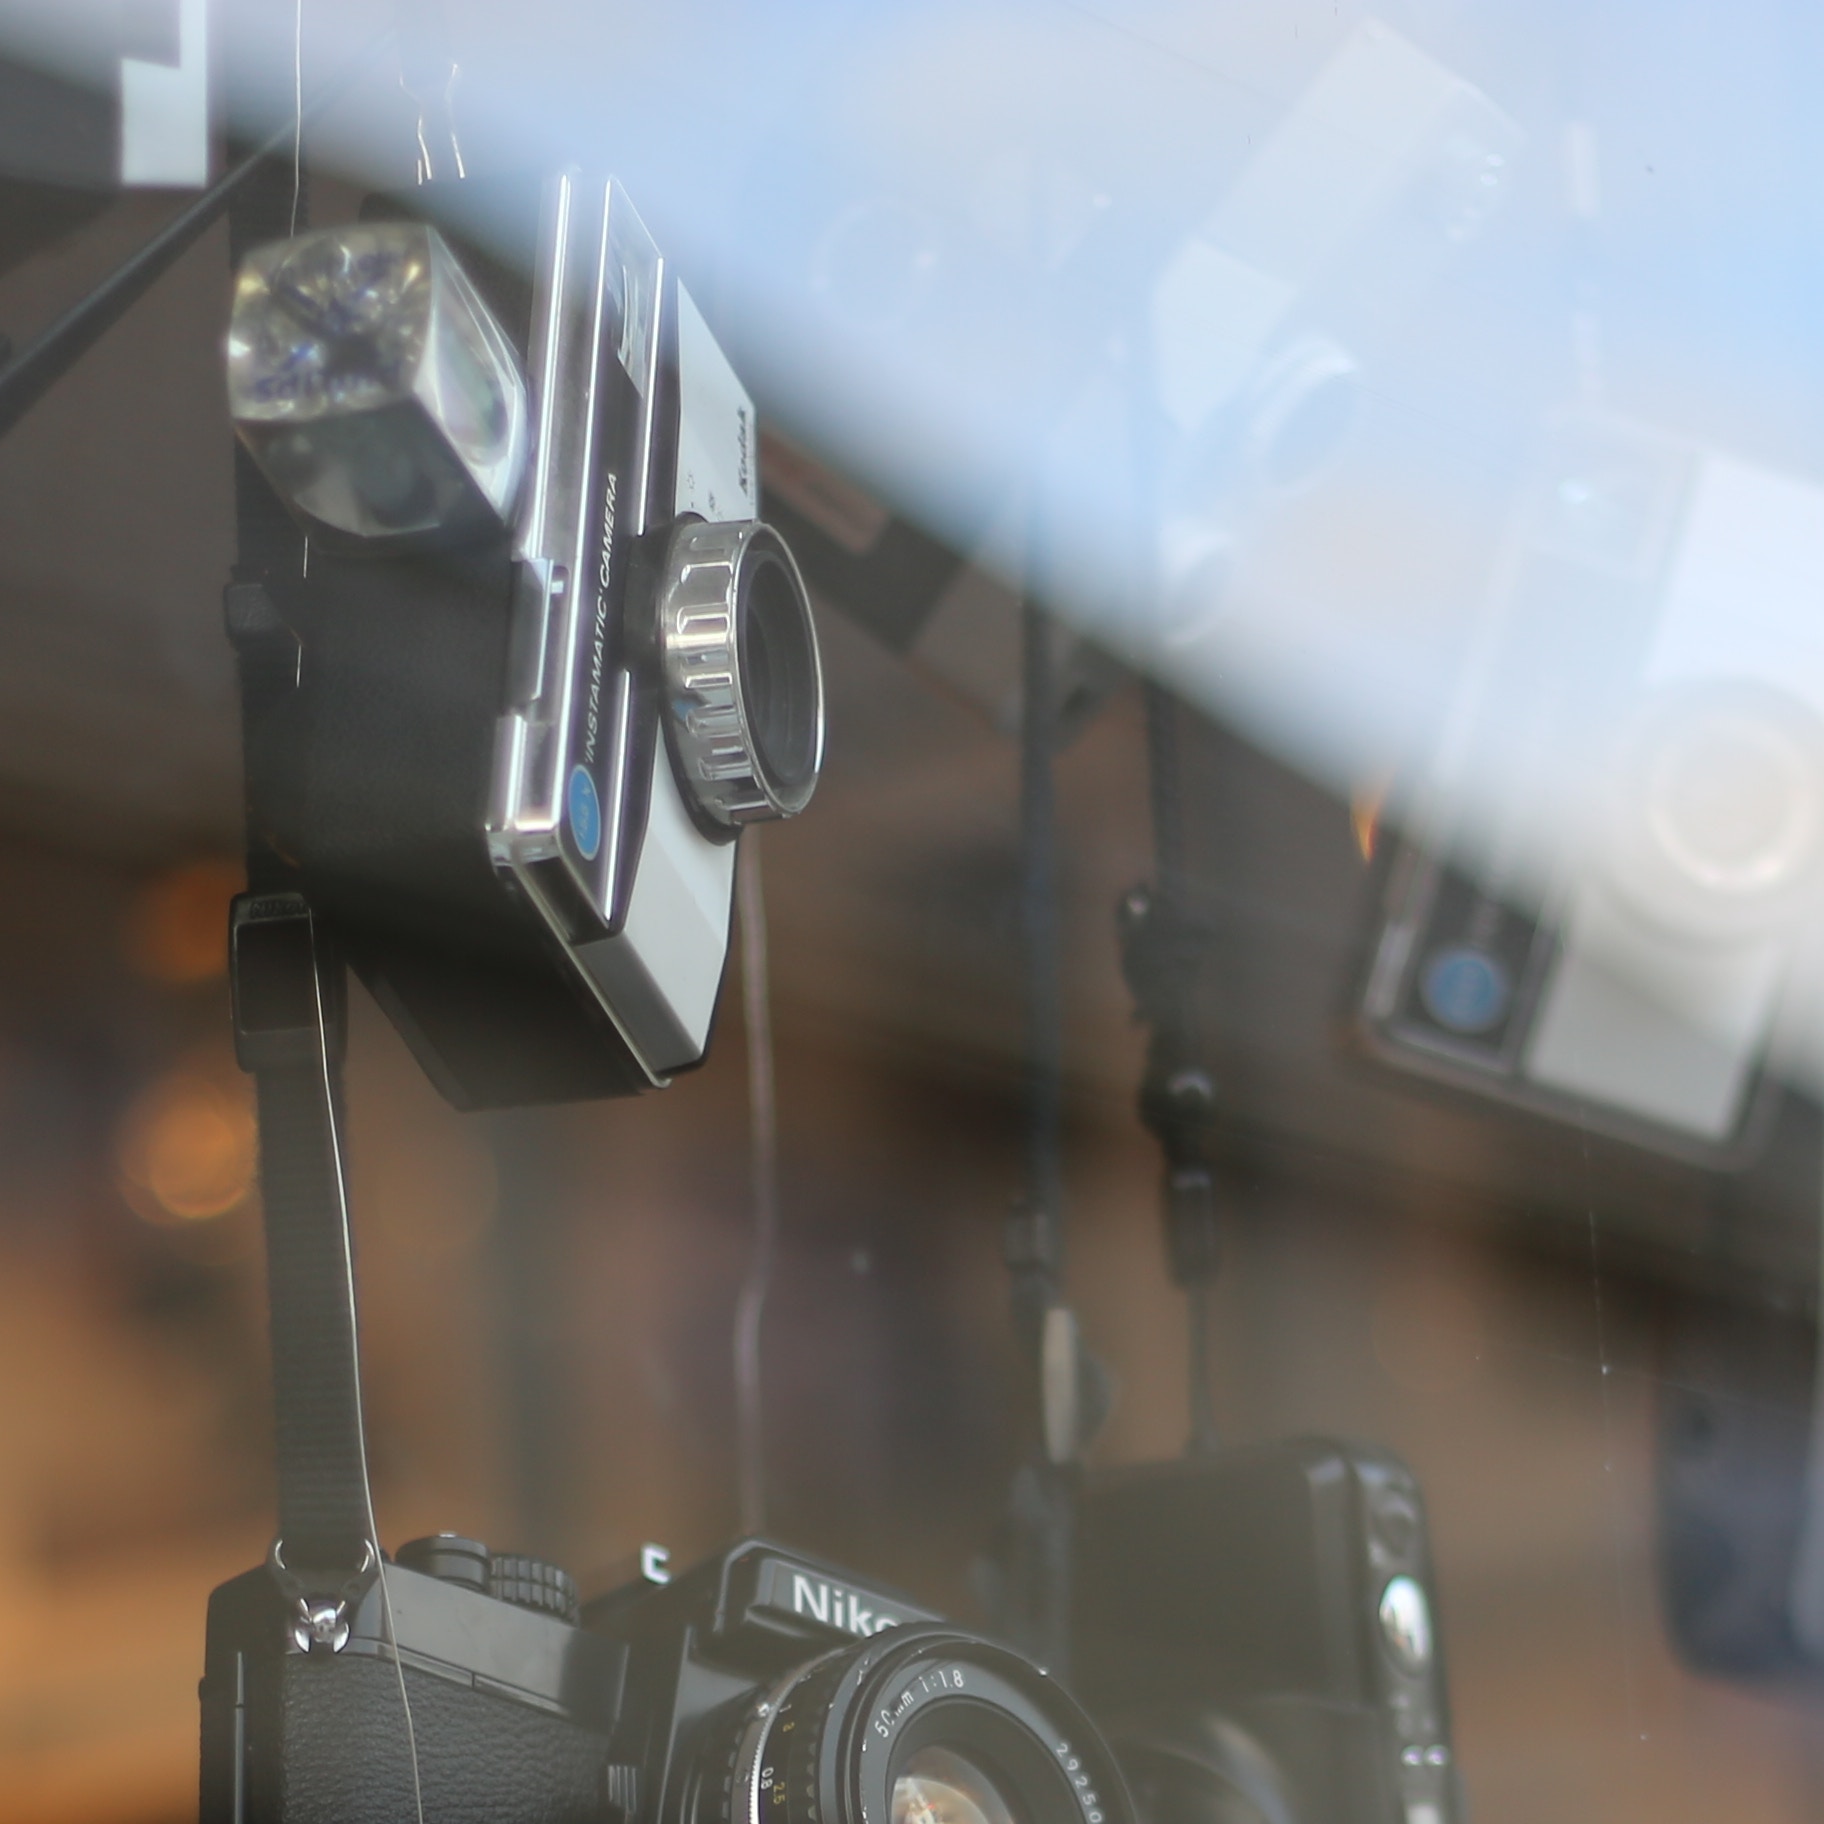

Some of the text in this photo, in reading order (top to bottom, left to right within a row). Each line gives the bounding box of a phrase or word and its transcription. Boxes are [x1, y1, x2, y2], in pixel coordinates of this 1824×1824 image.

[599, 473, 616, 589] CAMERA
[792, 1574, 898, 1638] Nik
[761, 1766, 774, 1790] 0.8
